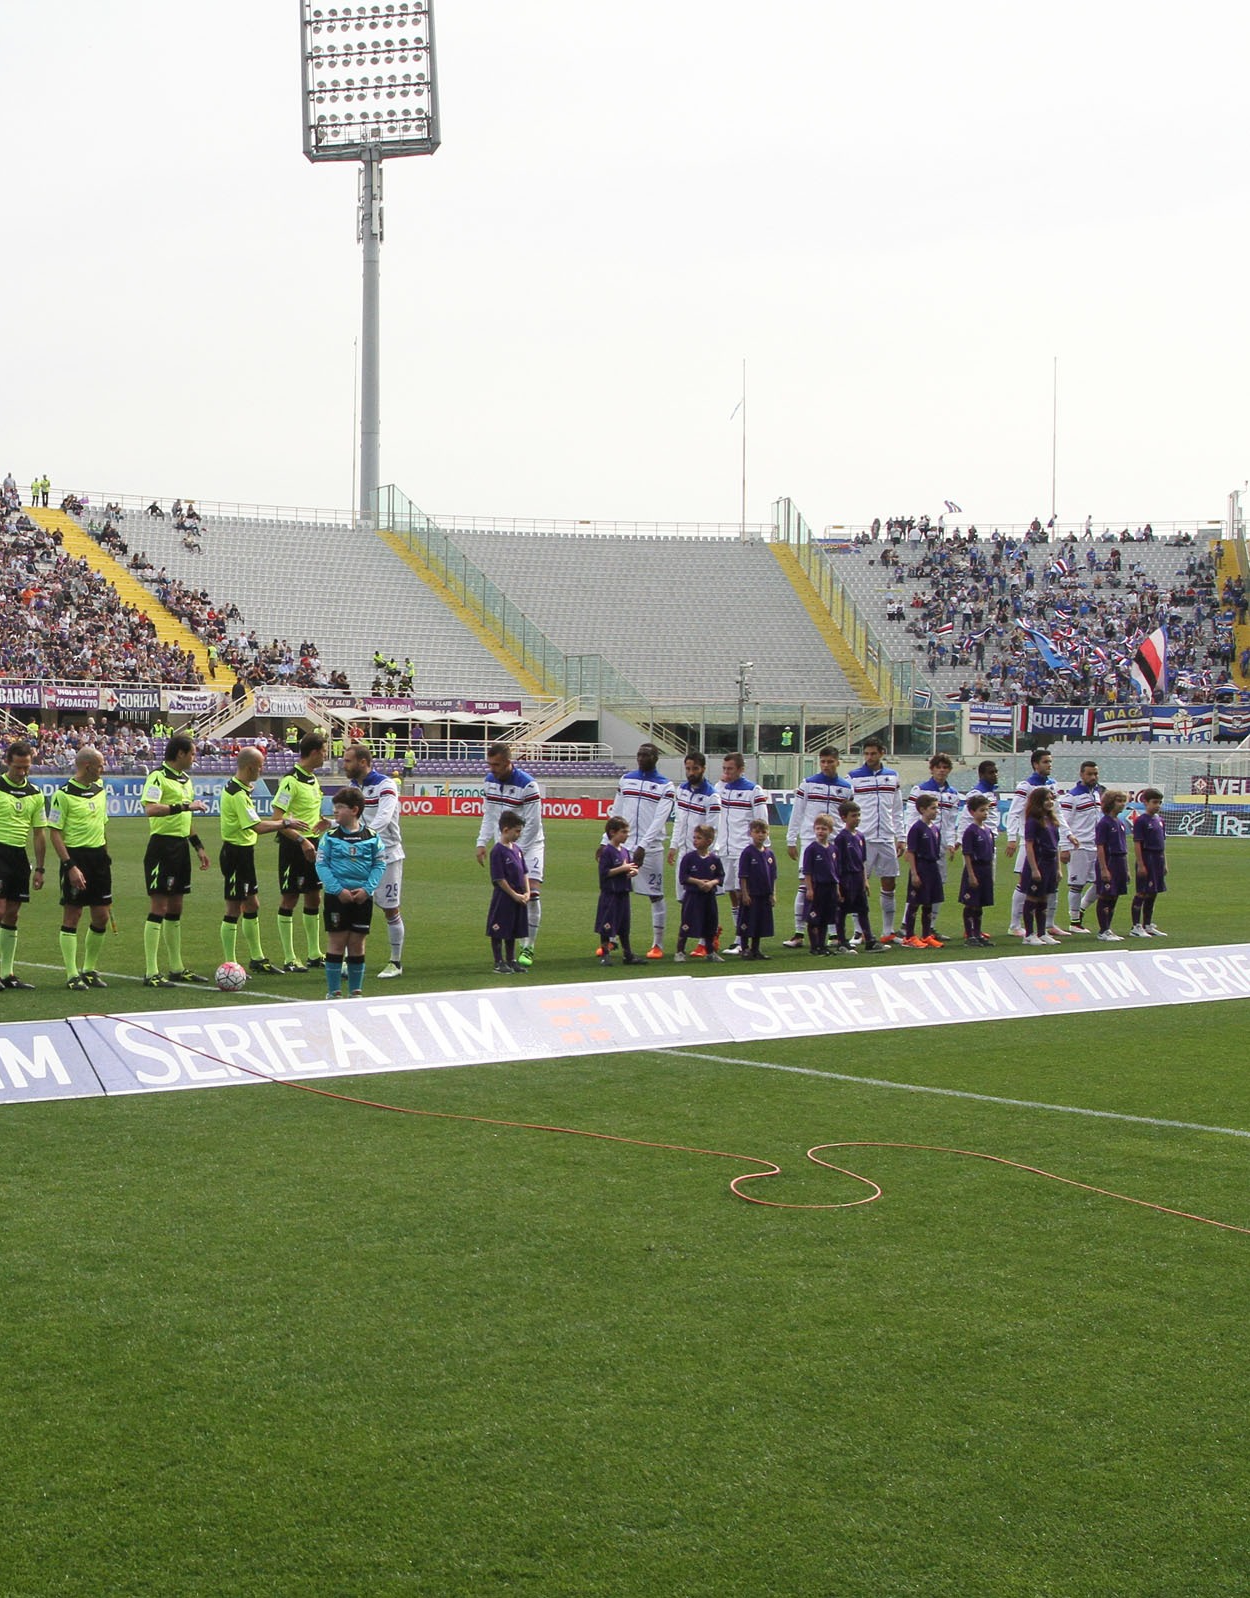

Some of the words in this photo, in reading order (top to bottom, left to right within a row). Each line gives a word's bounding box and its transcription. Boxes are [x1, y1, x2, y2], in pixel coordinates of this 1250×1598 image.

[57, 688, 79, 696] VIOLA
[55, 697, 98, 708] SPEDALETTO
[119, 692, 160, 708] GORIZIA
[271, 702, 304, 714] CHIANA
[1033, 707, 1084, 729] QUEZZI
[533, 857, 539, 868] 2
[648, 873, 663, 885] 23
[385, 883, 398, 898] 29
[1064, 960, 1150, 1000] TIM
[725, 980, 884, 1035] SERIE
[870, 972, 928, 1024] A
[900, 965, 1018, 1018] TIM
[594, 989, 709, 1039] TIM
[114, 1017, 330, 1085] SERIE
[324, 1008, 392, 1069] A
[369, 998, 520, 1062] TIM
